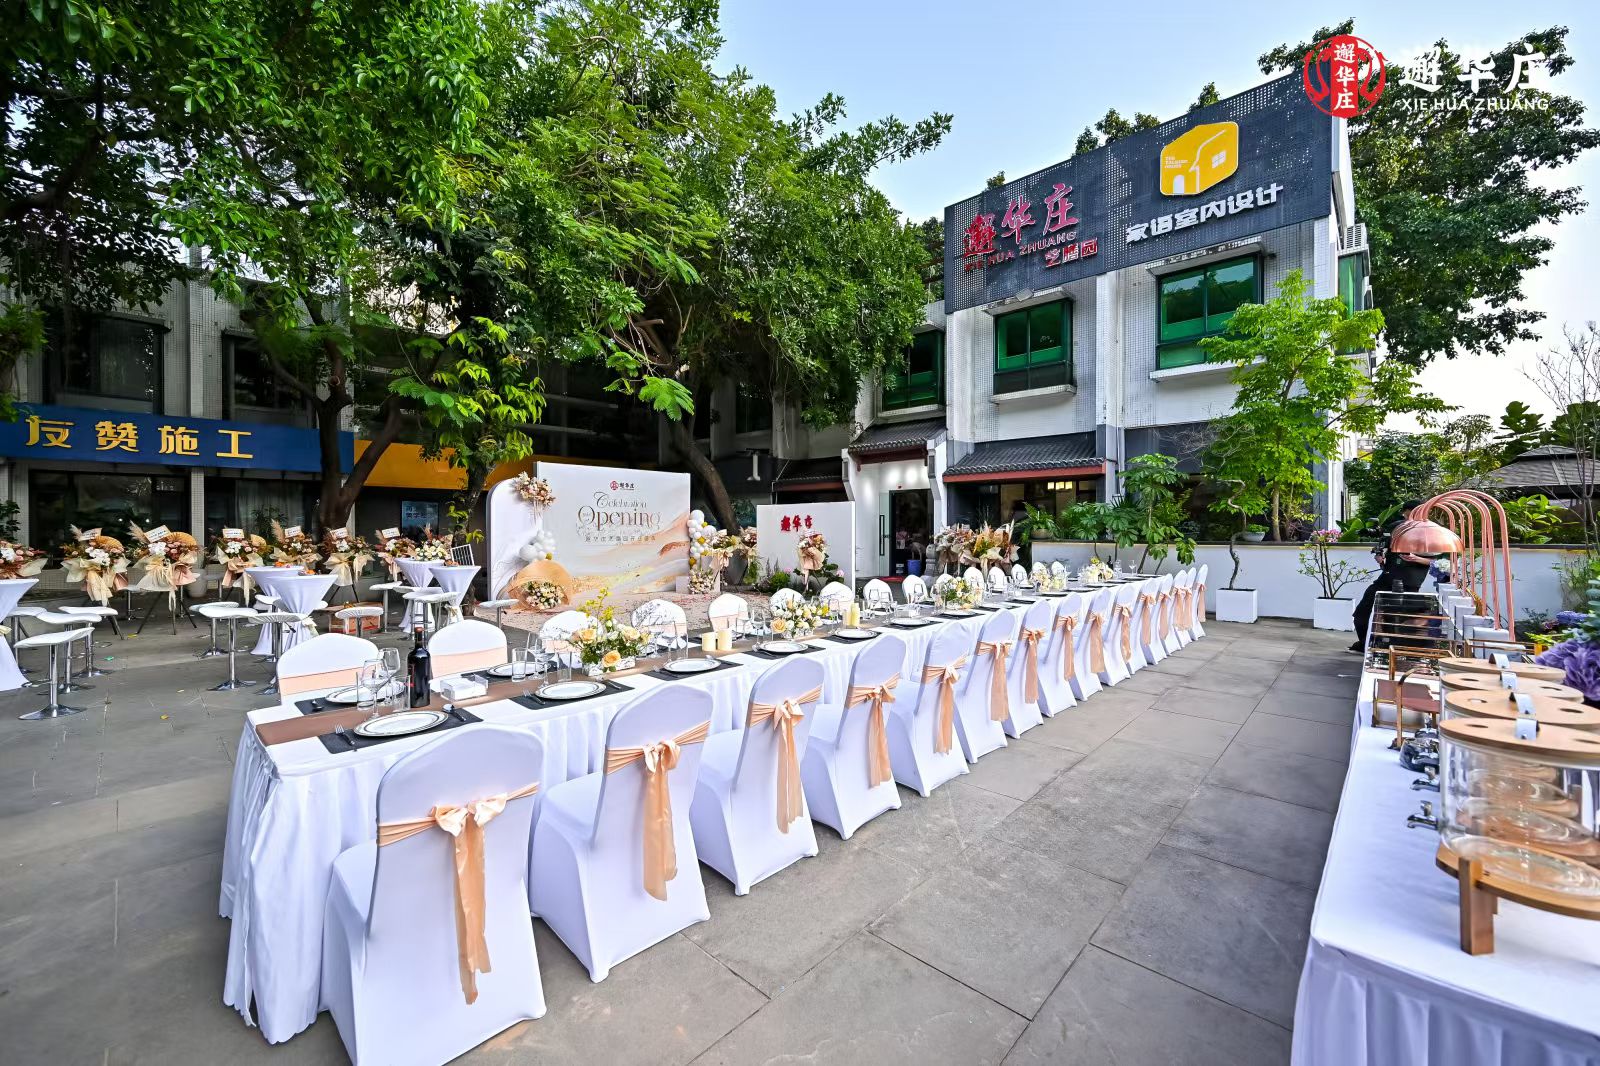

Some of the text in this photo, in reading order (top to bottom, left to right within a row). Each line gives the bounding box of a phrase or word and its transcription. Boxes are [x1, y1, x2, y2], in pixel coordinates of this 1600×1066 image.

[963, 182, 1080, 259] 邂华庄
[1125, 182, 1284, 244] 家语室内设计
[1019, 231, 1078, 256] ZHUANG
[25, 415, 254, 459] 友赞施工
[578, 505, 661, 531] Opening
